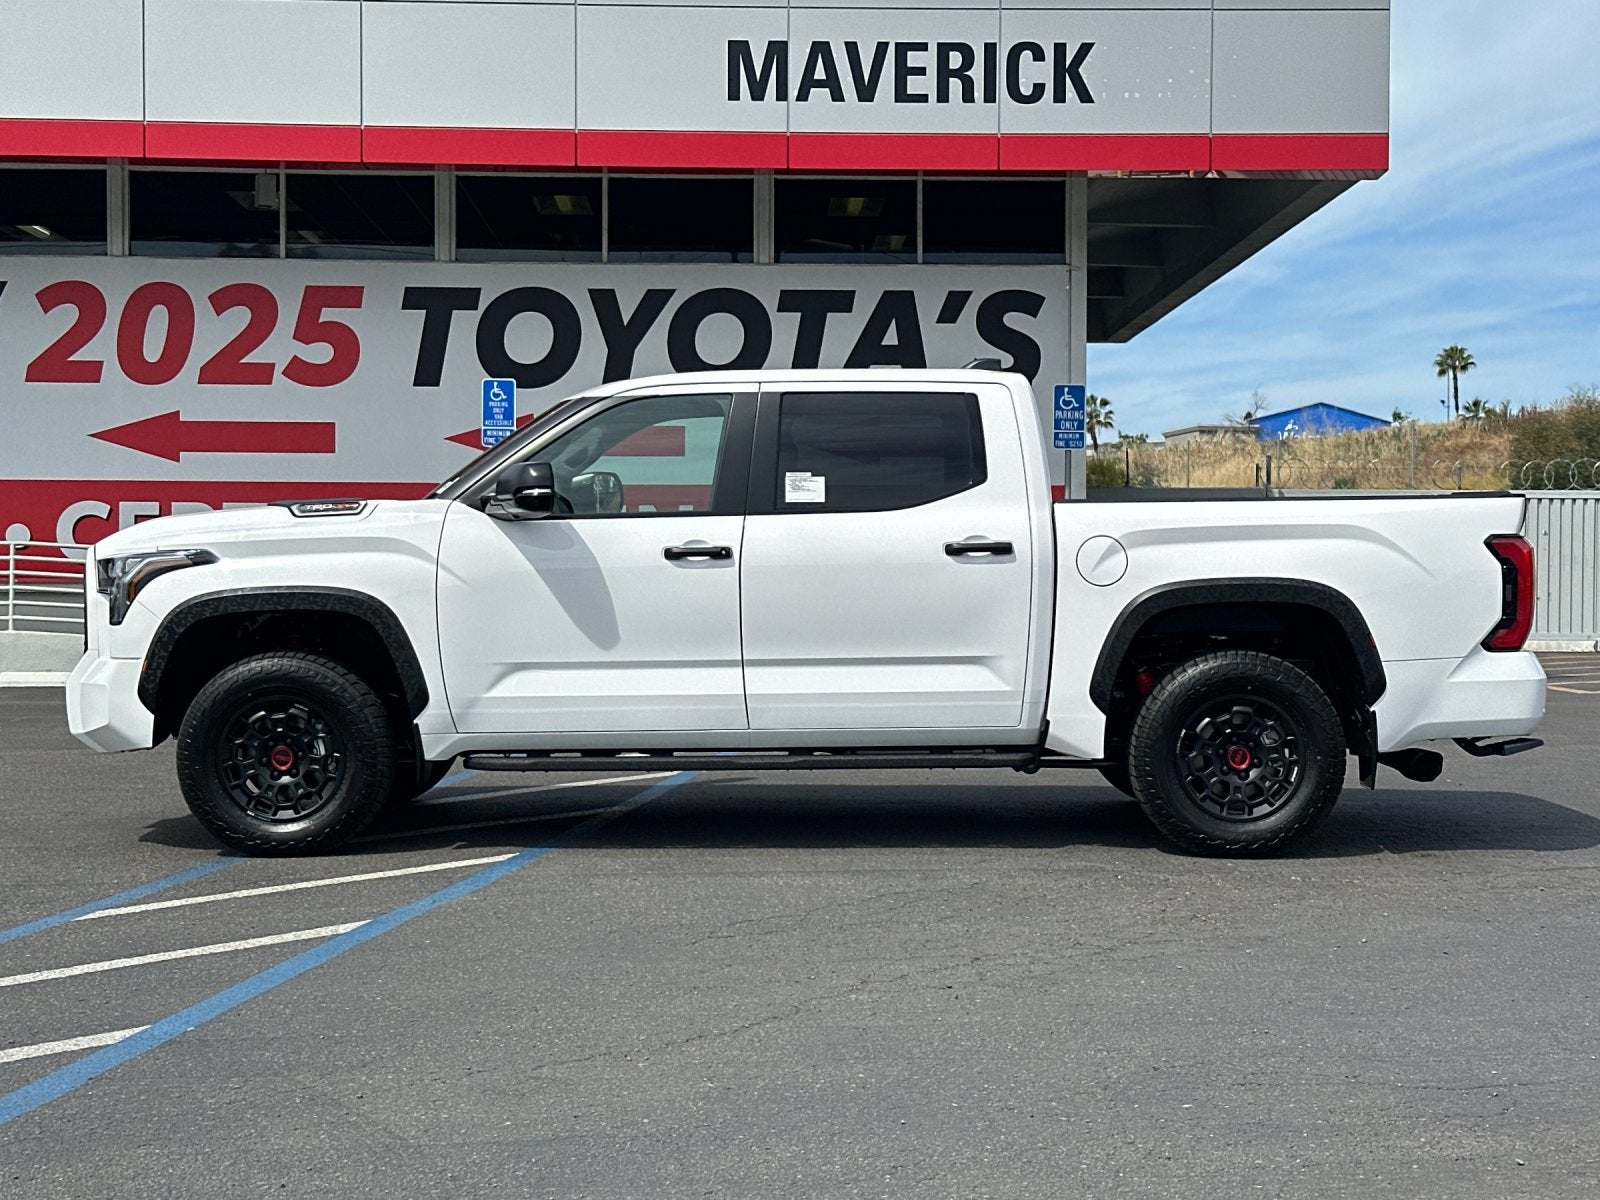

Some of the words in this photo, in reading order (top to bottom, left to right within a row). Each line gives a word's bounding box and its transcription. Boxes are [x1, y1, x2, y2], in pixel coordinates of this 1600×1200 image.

[727, 40, 1096, 105] MAVERICK
[25, 280, 365, 387] 2025
[401, 286, 1046, 389] TOYOTA'S
[1055, 410, 1084, 420] PARKING
[1060, 420, 1079, 430] ONLY
